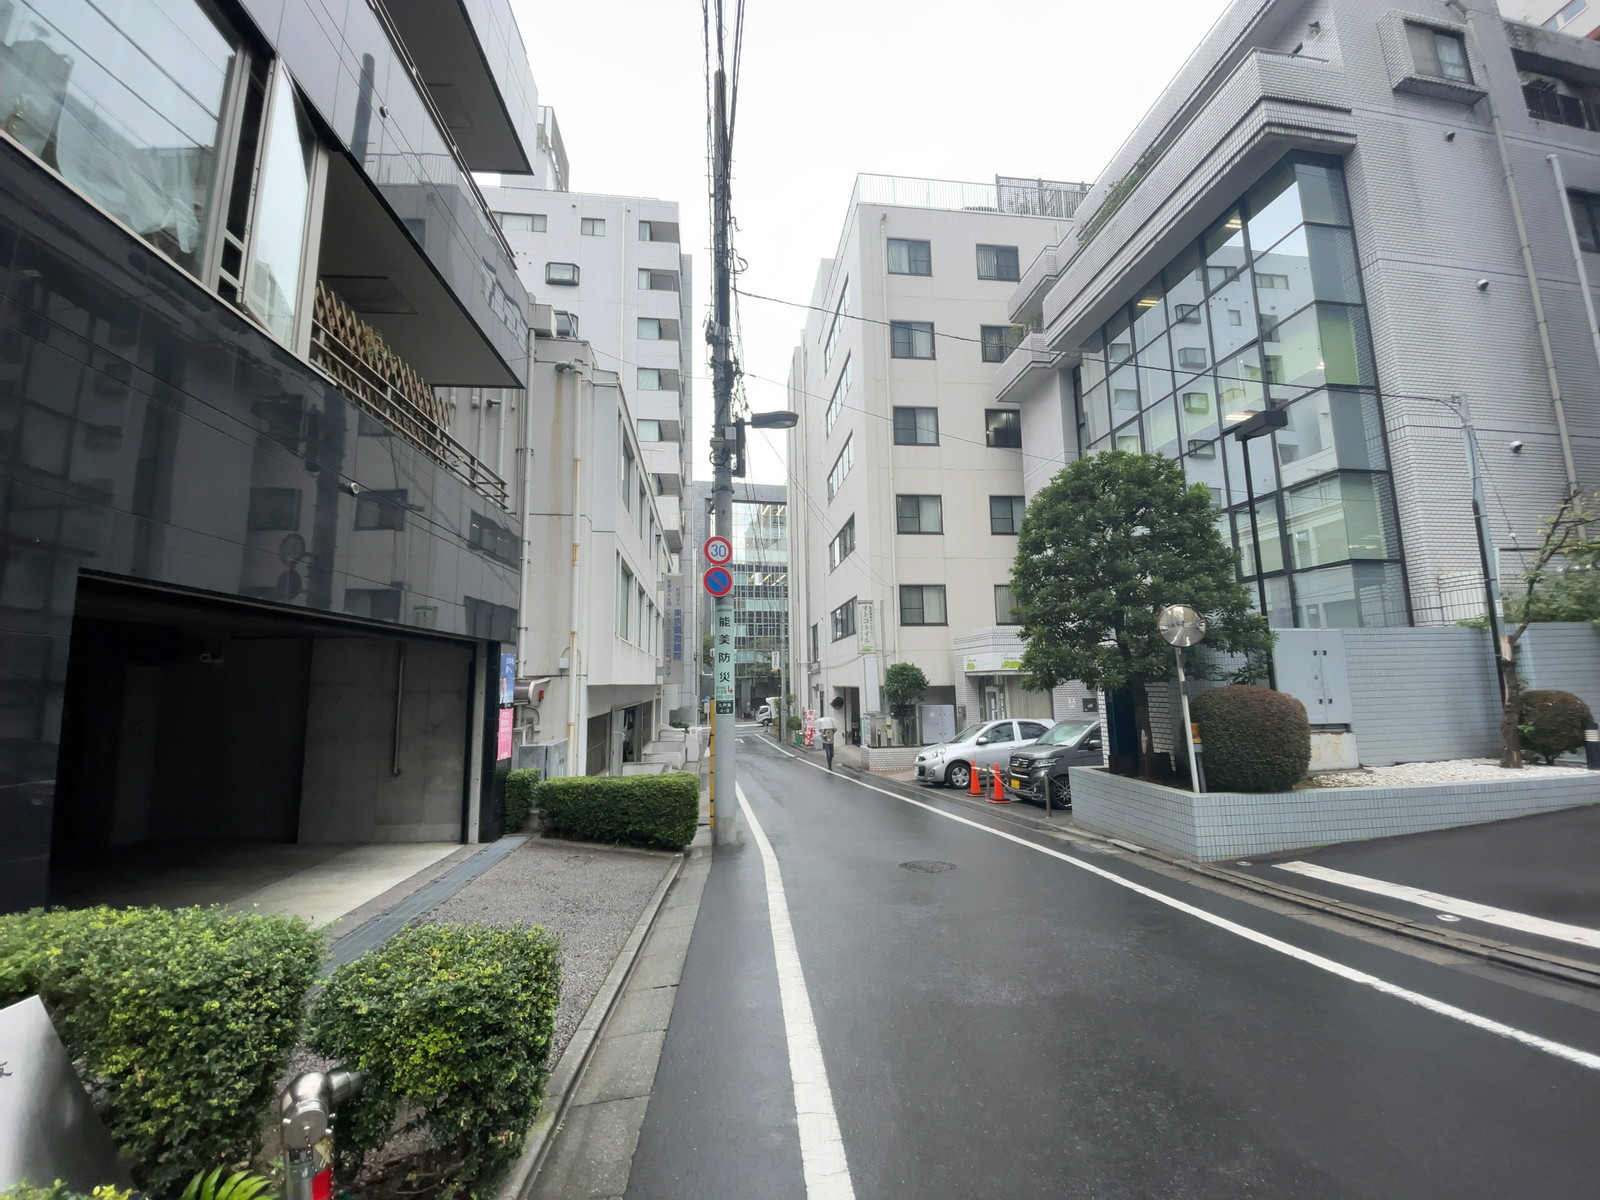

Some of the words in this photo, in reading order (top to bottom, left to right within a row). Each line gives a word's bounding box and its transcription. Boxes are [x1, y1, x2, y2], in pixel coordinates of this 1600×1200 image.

[711, 545, 727, 558] 30
[718, 616, 731, 683] 能美防災
